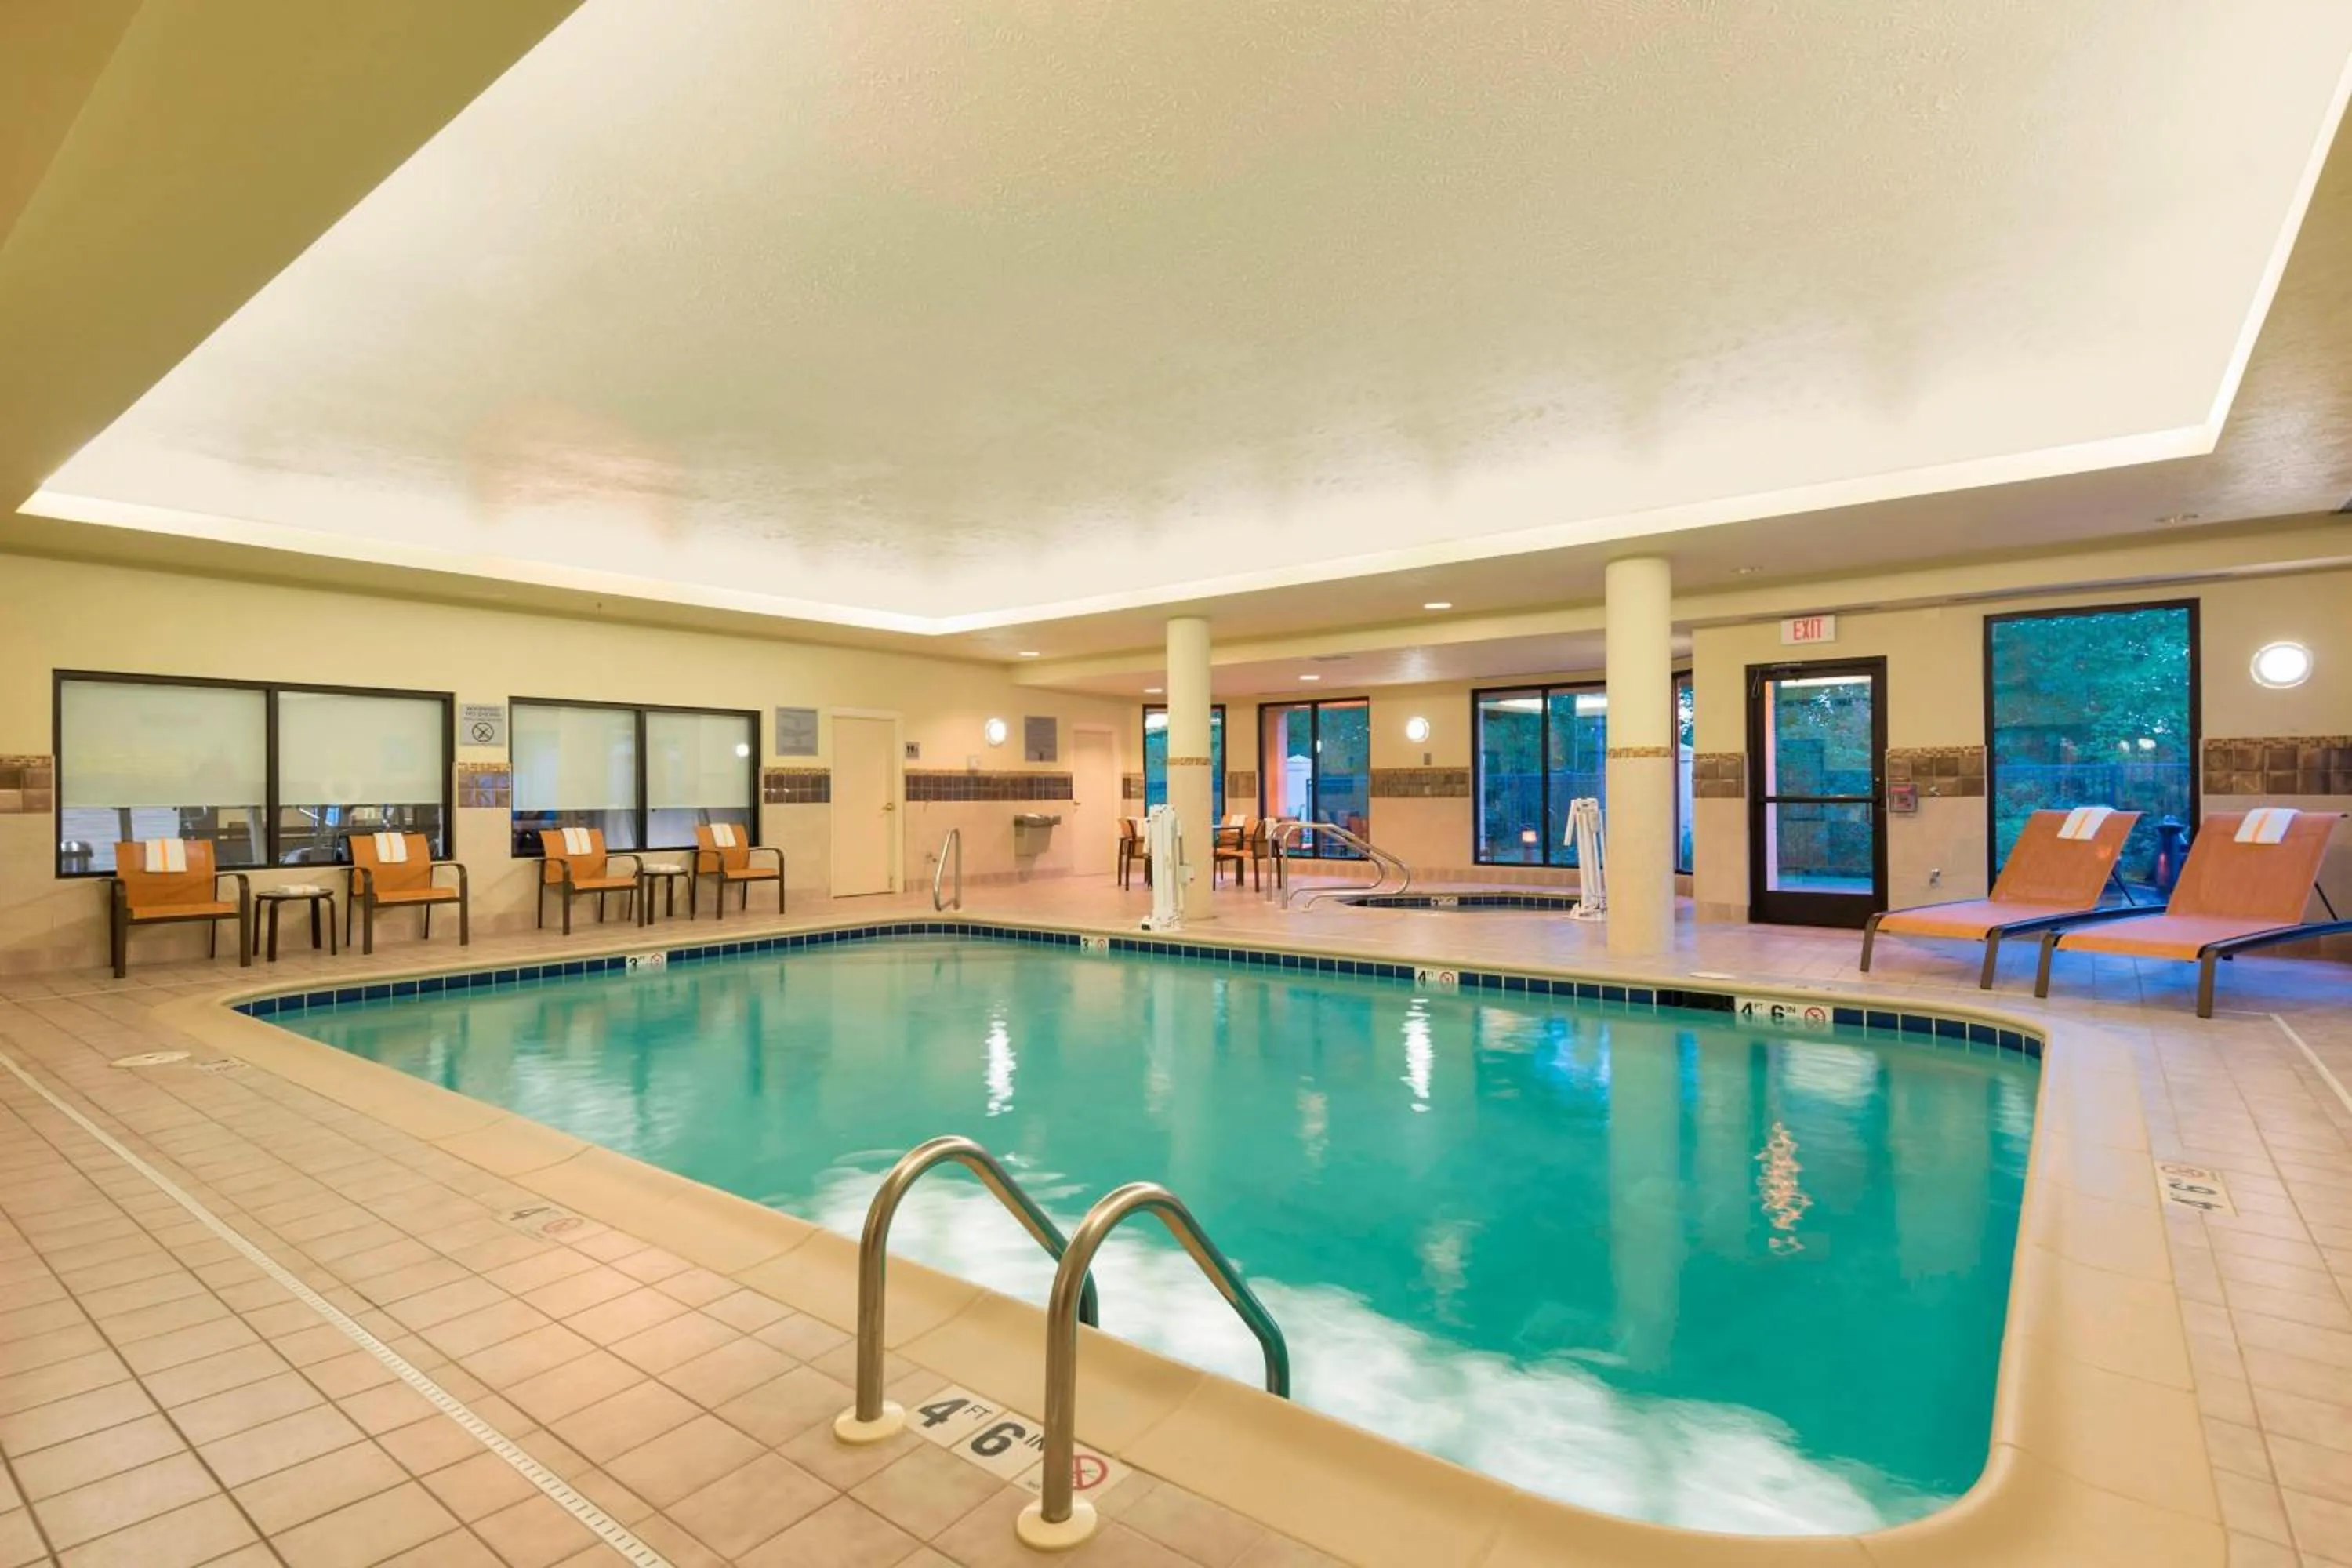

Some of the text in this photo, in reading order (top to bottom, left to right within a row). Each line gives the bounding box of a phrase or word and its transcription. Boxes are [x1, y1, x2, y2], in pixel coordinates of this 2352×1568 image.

[1793, 619, 1821, 640] EXIT
[1771, 1004, 1785, 1018] 6
[509, 1207, 551, 1221] 4
[918, 1398, 970, 1429] 4
[964, 1403, 992, 1420] FT
[971, 1421, 1026, 1457] 6
